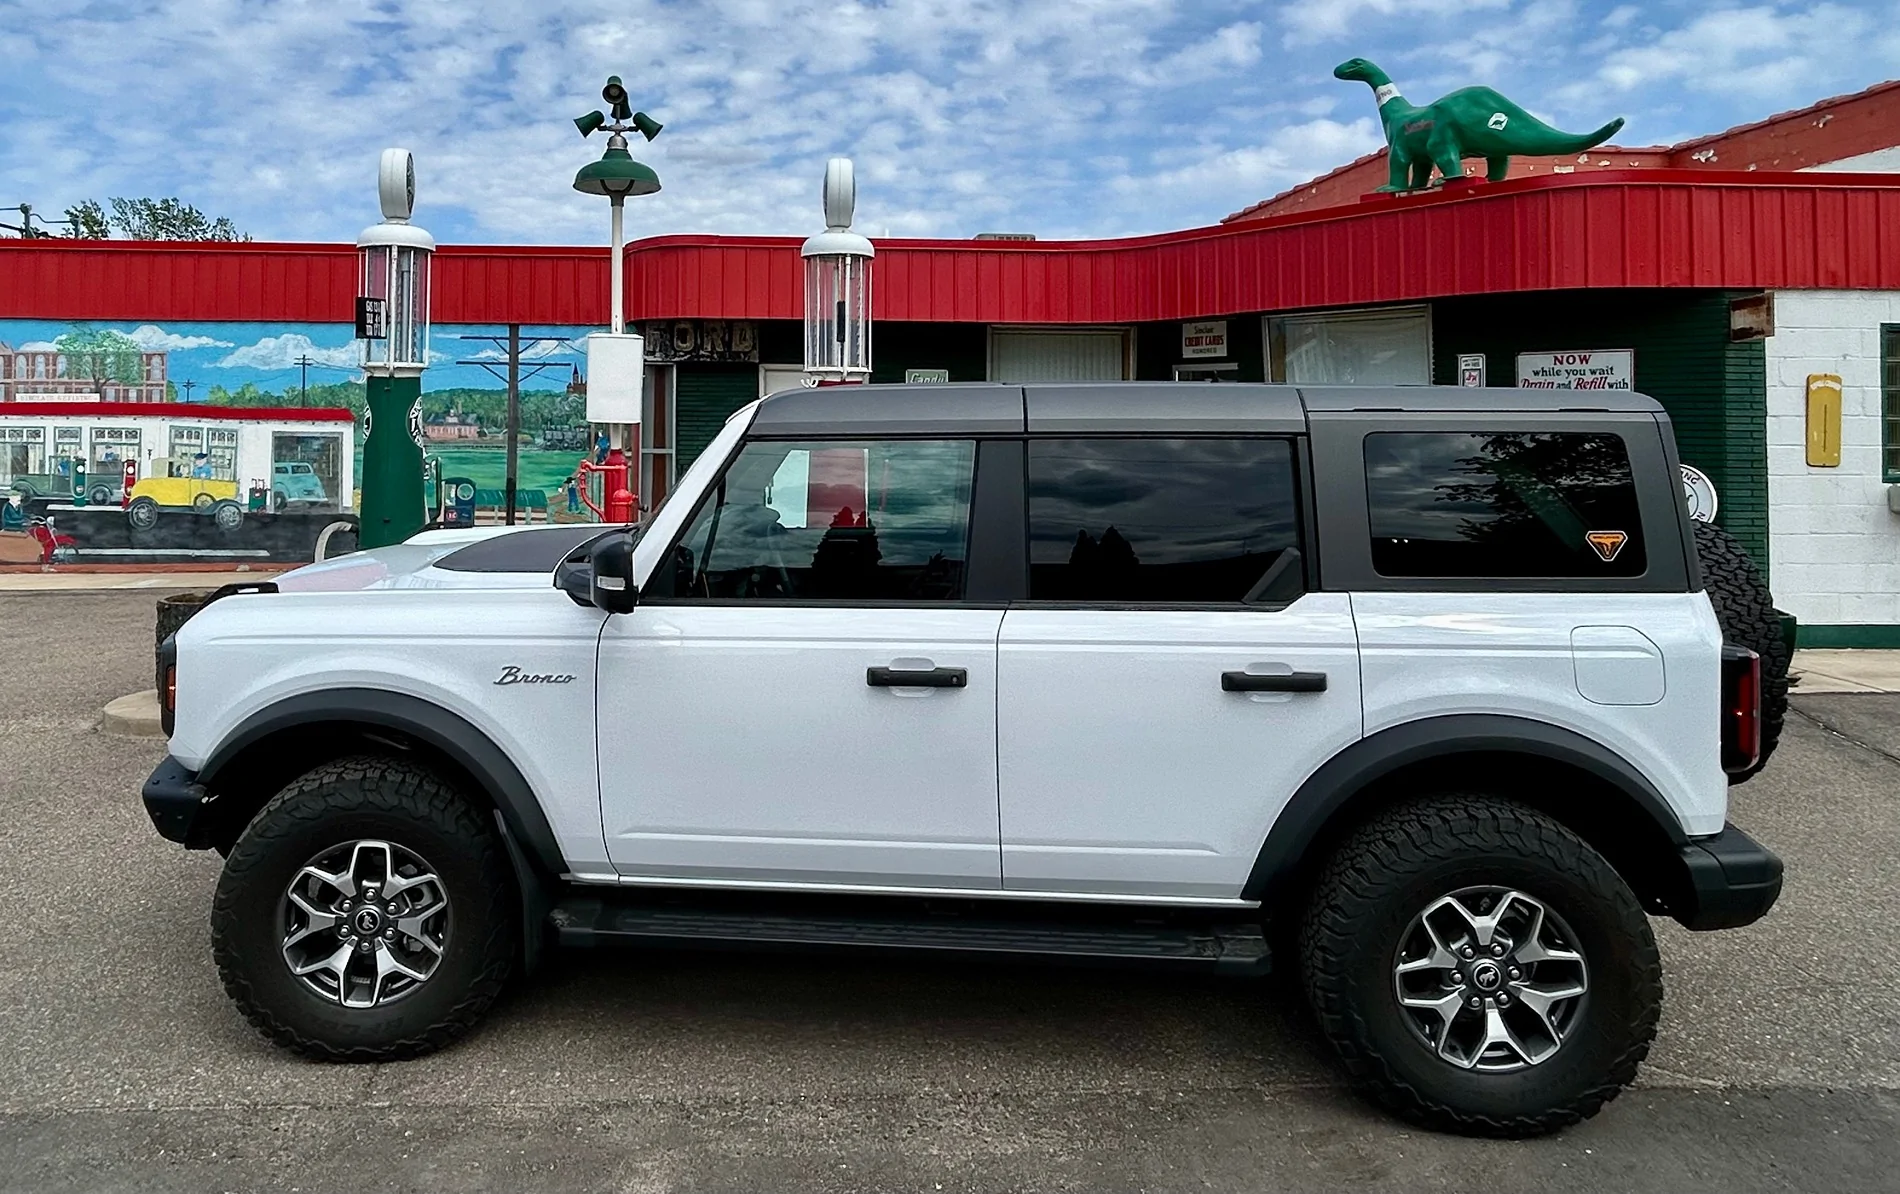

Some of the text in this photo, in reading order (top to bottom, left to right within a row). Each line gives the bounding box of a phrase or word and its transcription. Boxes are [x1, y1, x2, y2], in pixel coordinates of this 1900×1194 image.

[1185, 335, 1224, 347] CREDIT CARDS
[1553, 354, 1592, 366] NOW
[1532, 366, 1614, 379] while you wait
[1521, 376, 1629, 389] Drain and Refill with
[493, 666, 577, 685] Bronco
